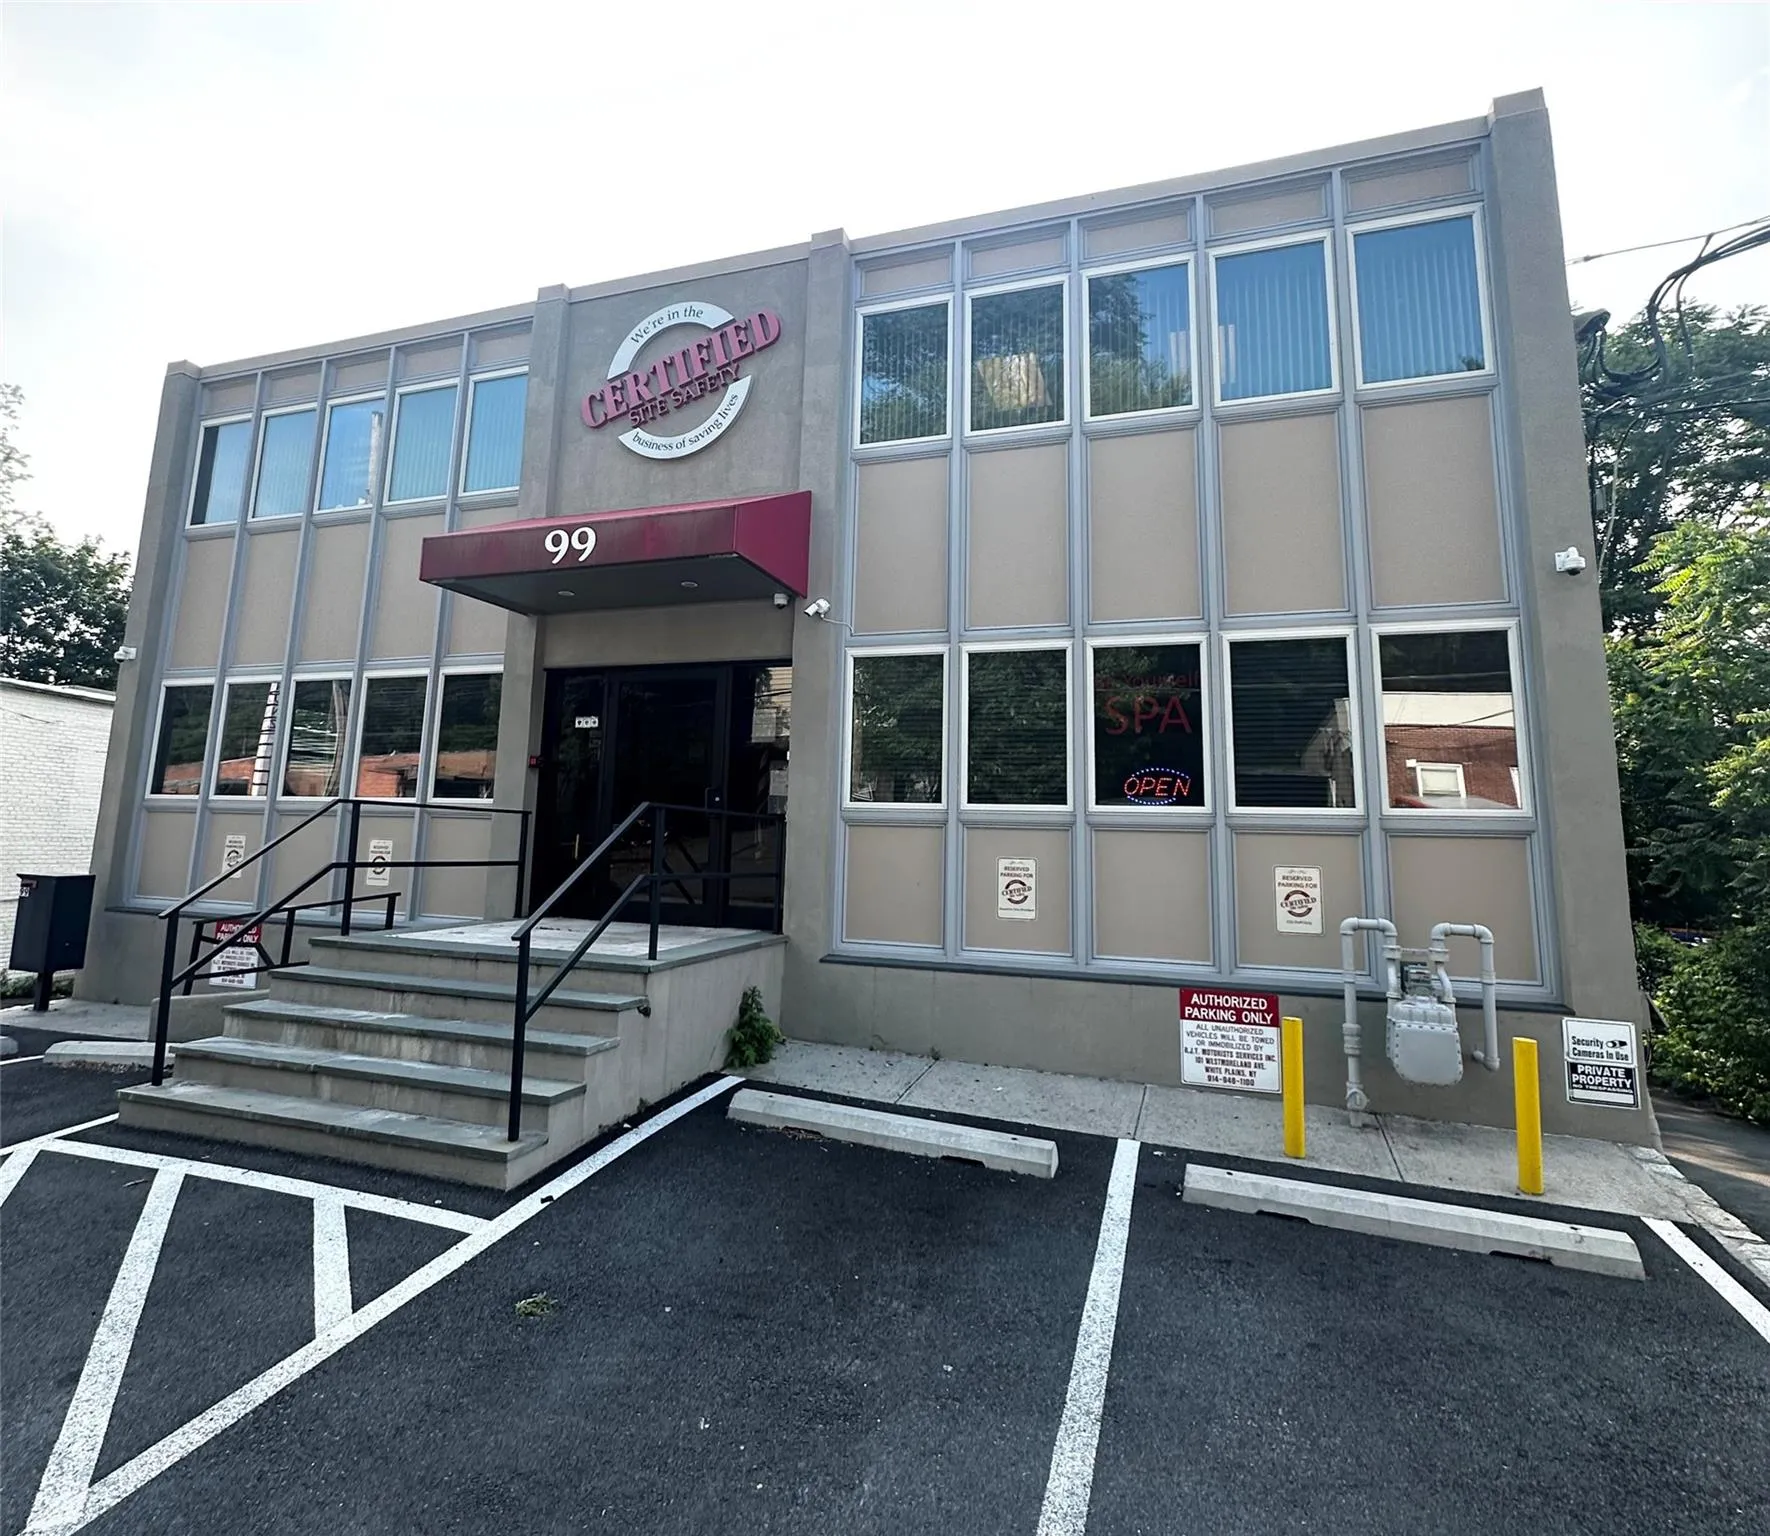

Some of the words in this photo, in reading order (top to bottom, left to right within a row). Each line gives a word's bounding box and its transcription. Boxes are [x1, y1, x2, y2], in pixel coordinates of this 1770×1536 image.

[631, 315, 664, 345] We're
[667, 310, 680, 322] in
[683, 306, 704, 318] the
[581, 308, 782, 428] CERTIFIED
[629, 400, 669, 427] SITE
[671, 364, 740, 408] SAFETY
[632, 432, 674, 451] business
[675, 437, 687, 450] of
[688, 418, 723, 444] saving
[718, 393, 739, 420] lives
[544, 526, 597, 564] 99
[1104, 695, 1192, 735] SPA
[1124, 777, 1192, 797] OPEN
[243, 934, 259, 943] ONLY
[1191, 994, 1267, 1010] AUTHORIZED
[1185, 1007, 1236, 1021] PARKING
[1242, 1011, 1273, 1024] ONLY
[1211, 1025, 1264, 1035] UNAUTHORIZED
[1186, 1031, 1218, 1040] VEHICLES
[1251, 1036, 1275, 1044] TOWED
[1572, 1036, 1603, 1049] Security
[1208, 1040, 1251, 1051] IMMOBILIZED
[1254, 1044, 1263, 1052] BY
[1572, 1047, 1604, 1058] Cameras
[1606, 1050, 1613, 1060] In
[1615, 1051, 1629, 1061] Use
[1205, 1066, 1222, 1074] WHITE
[1577, 1064, 1626, 1077] PRIVATE
[1572, 1074, 1632, 1088] PROPERTY
[1585, 1085, 1633, 1093] TRESPASSING
